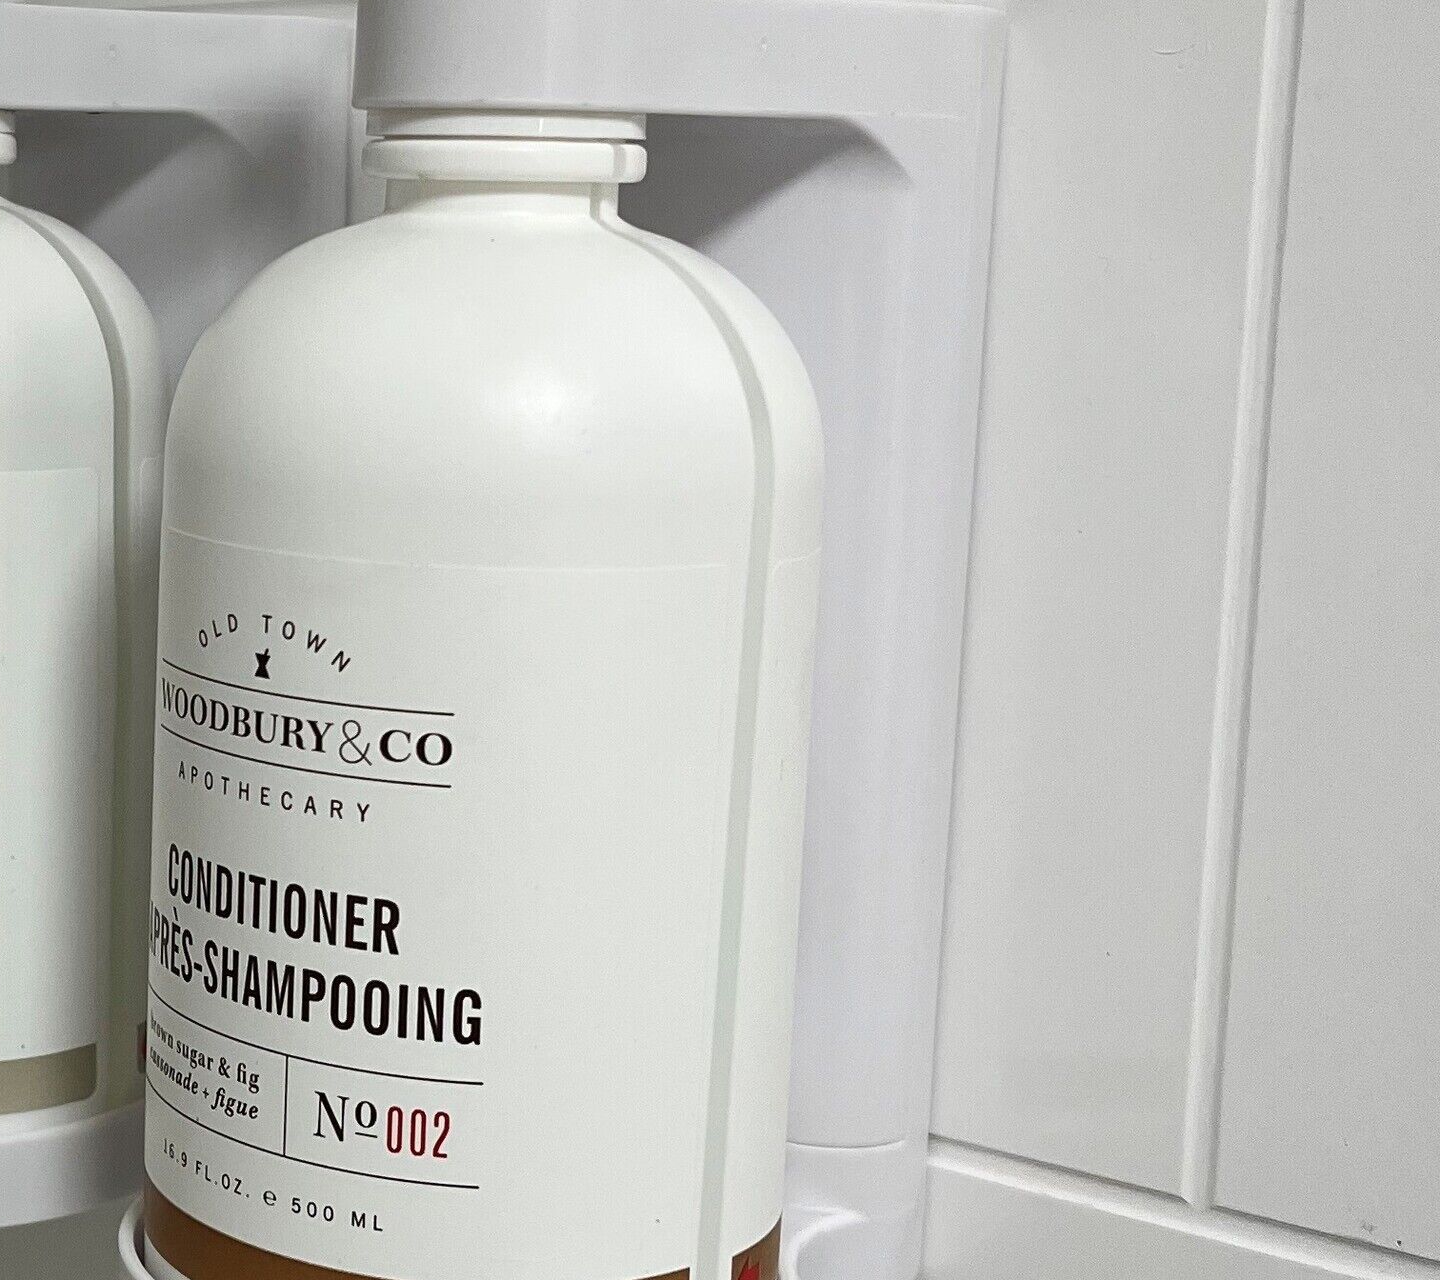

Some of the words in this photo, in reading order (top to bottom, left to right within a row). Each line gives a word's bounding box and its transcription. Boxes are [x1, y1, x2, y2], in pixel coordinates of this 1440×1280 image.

[199, 613, 238, 648] OLD
[262, 615, 351, 673] TOWN
[178, 760, 370, 823] APOTHECARY
[168, 843, 401, 956] CONDITIONER
[176, 1040, 214, 1071] sugar
[218, 1056, 231, 1079] &
[237, 1062, 260, 1094] fig
[202, 1087, 210, 1099] +
[211, 1086, 259, 1120] figue
[162, 1138, 188, 1168] 16.9
[291, 1197, 335, 1223] 500
[351, 1210, 384, 1232] ML
